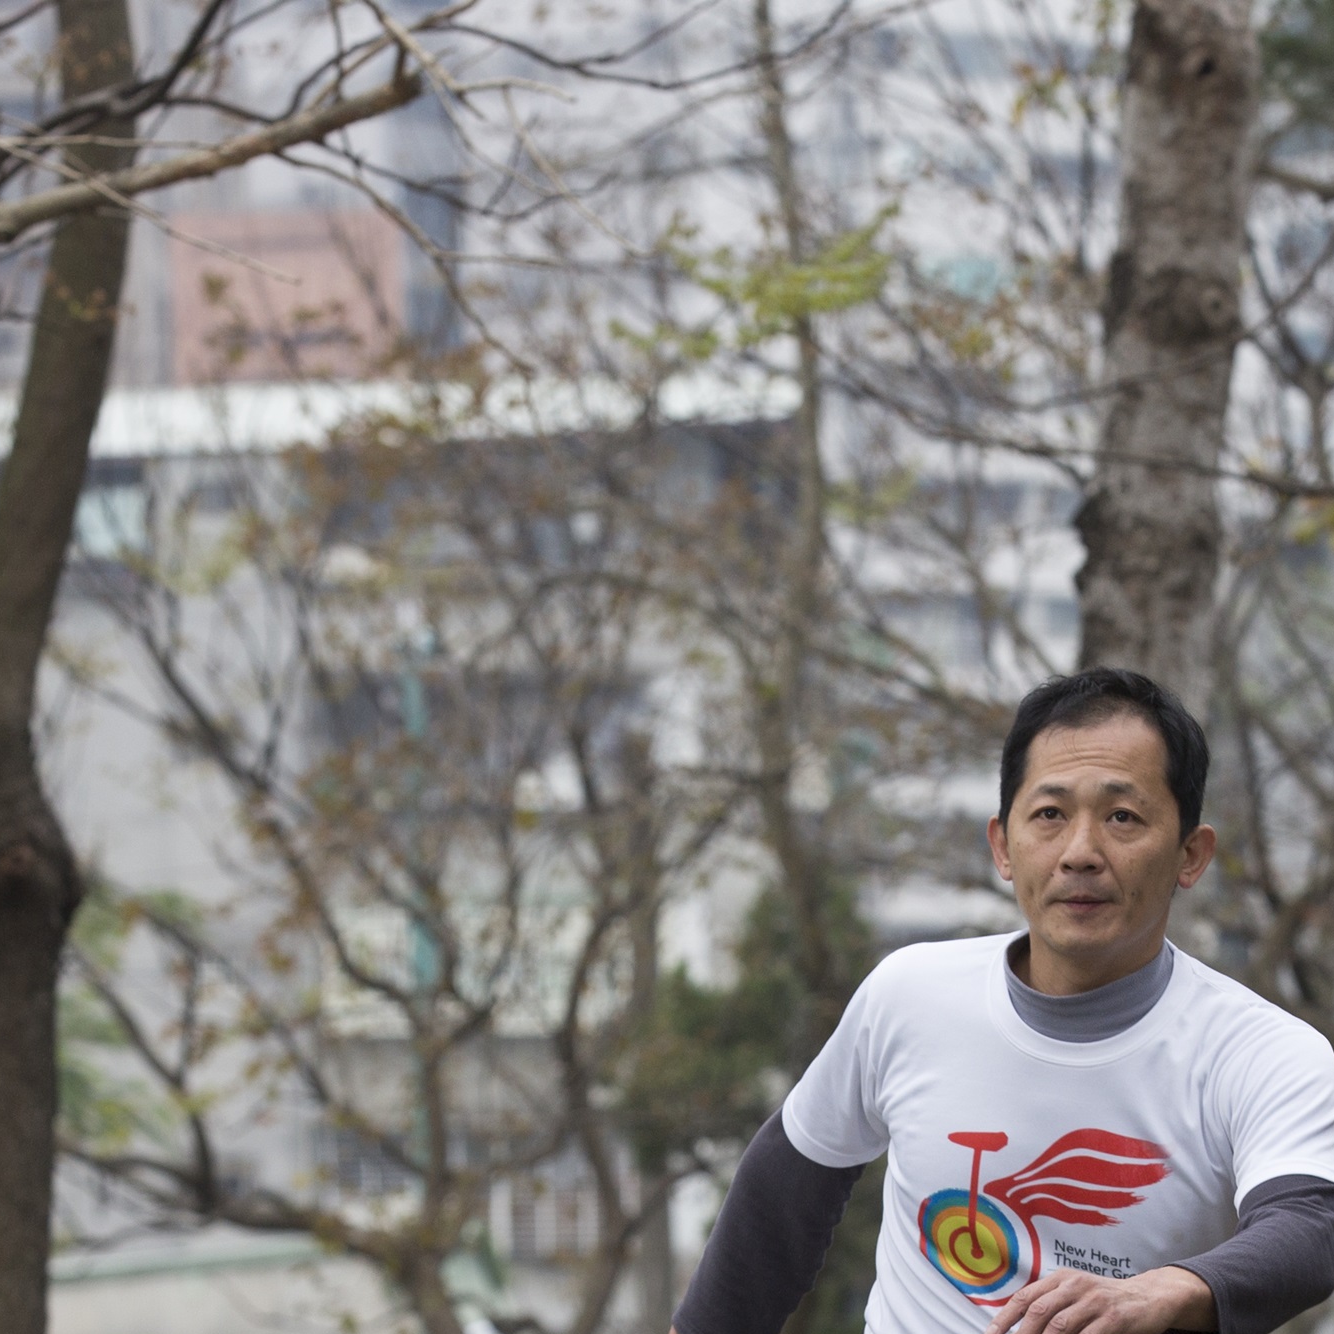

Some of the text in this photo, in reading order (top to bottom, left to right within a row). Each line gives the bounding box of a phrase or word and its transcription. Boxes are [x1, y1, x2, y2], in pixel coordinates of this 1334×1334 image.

[1054, 1252, 1108, 1276] Theater
[1055, 1239, 1131, 1268] New Heart
